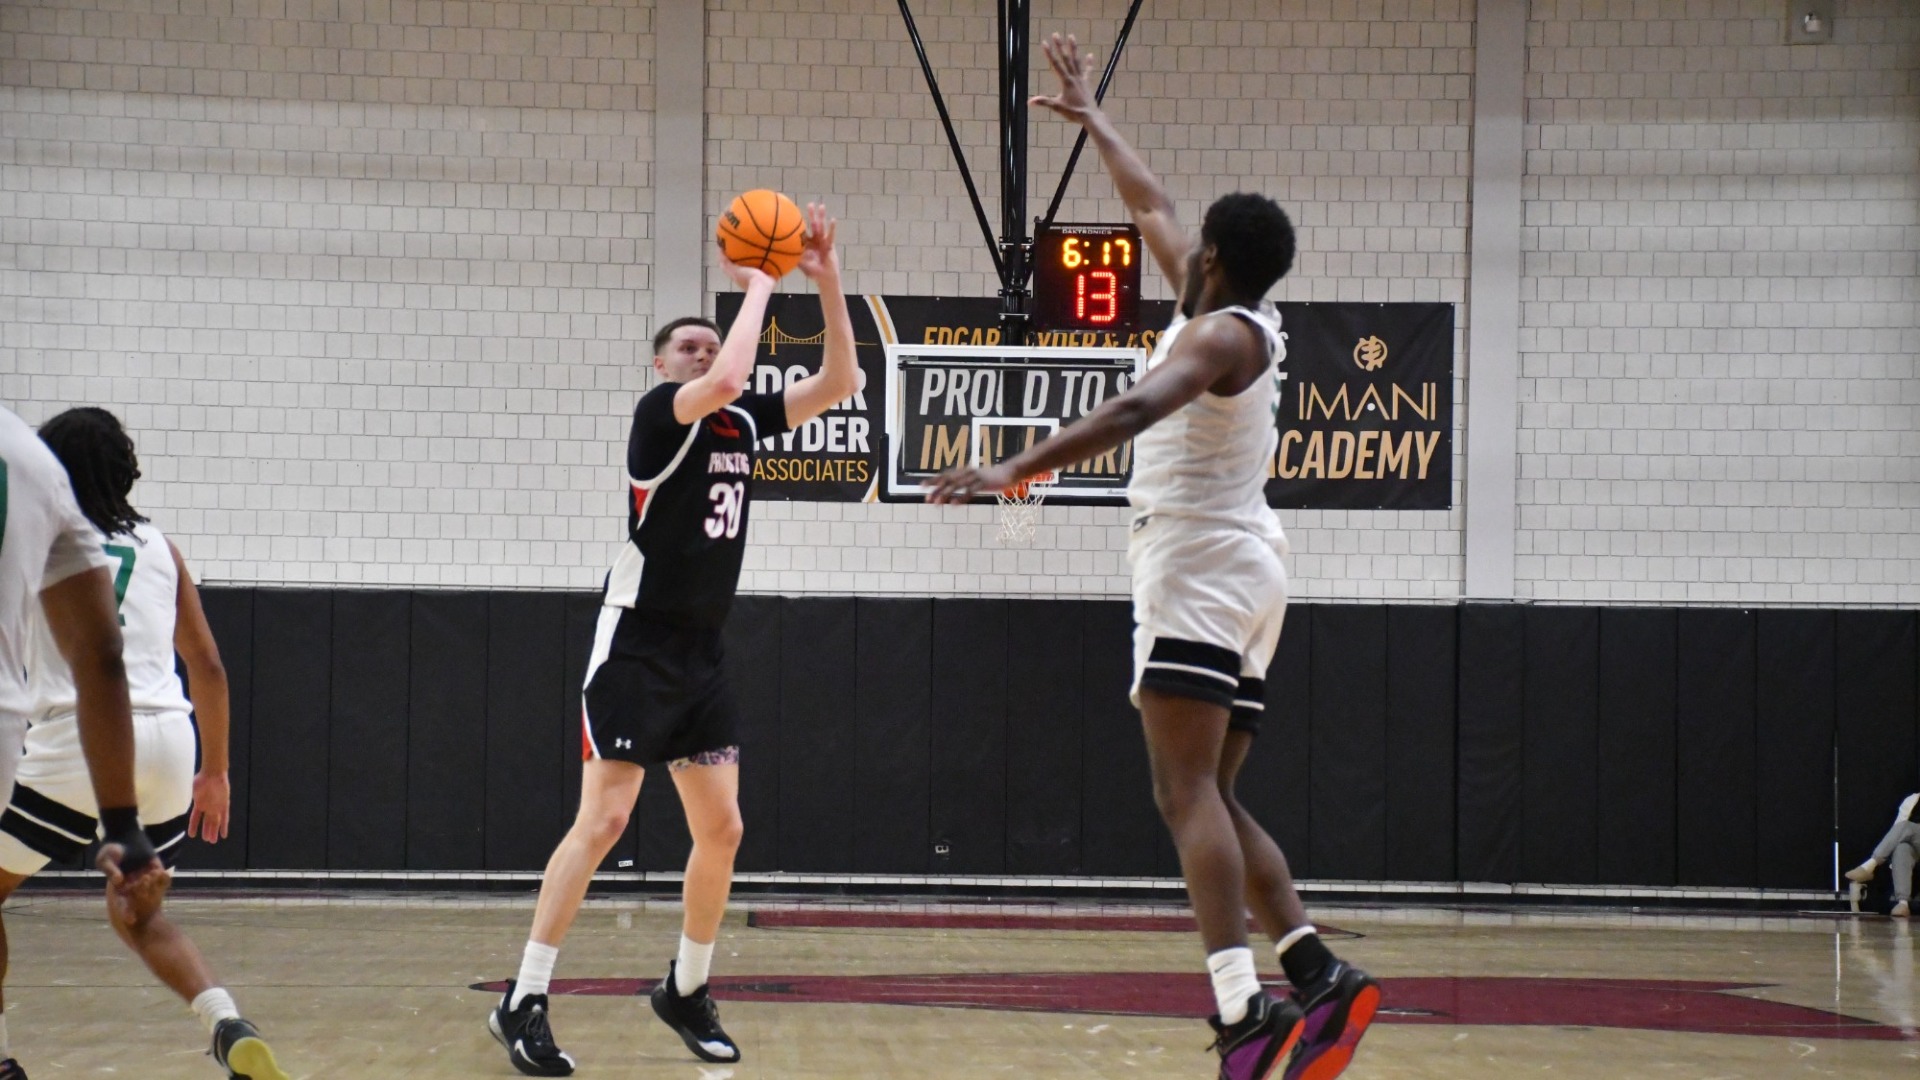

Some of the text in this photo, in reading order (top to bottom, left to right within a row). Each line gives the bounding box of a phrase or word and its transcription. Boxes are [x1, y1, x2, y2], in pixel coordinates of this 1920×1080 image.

[1062, 238, 1131, 268] 6:17
[1076, 271, 1116, 322] 13
[1061, 370, 1106, 418] TO
[1299, 382, 1436, 420] IMANI
[753, 458, 868, 482] ASSOCIATES
[1268, 430, 1441, 480] CADEMY
[704, 481, 744, 538] 30
